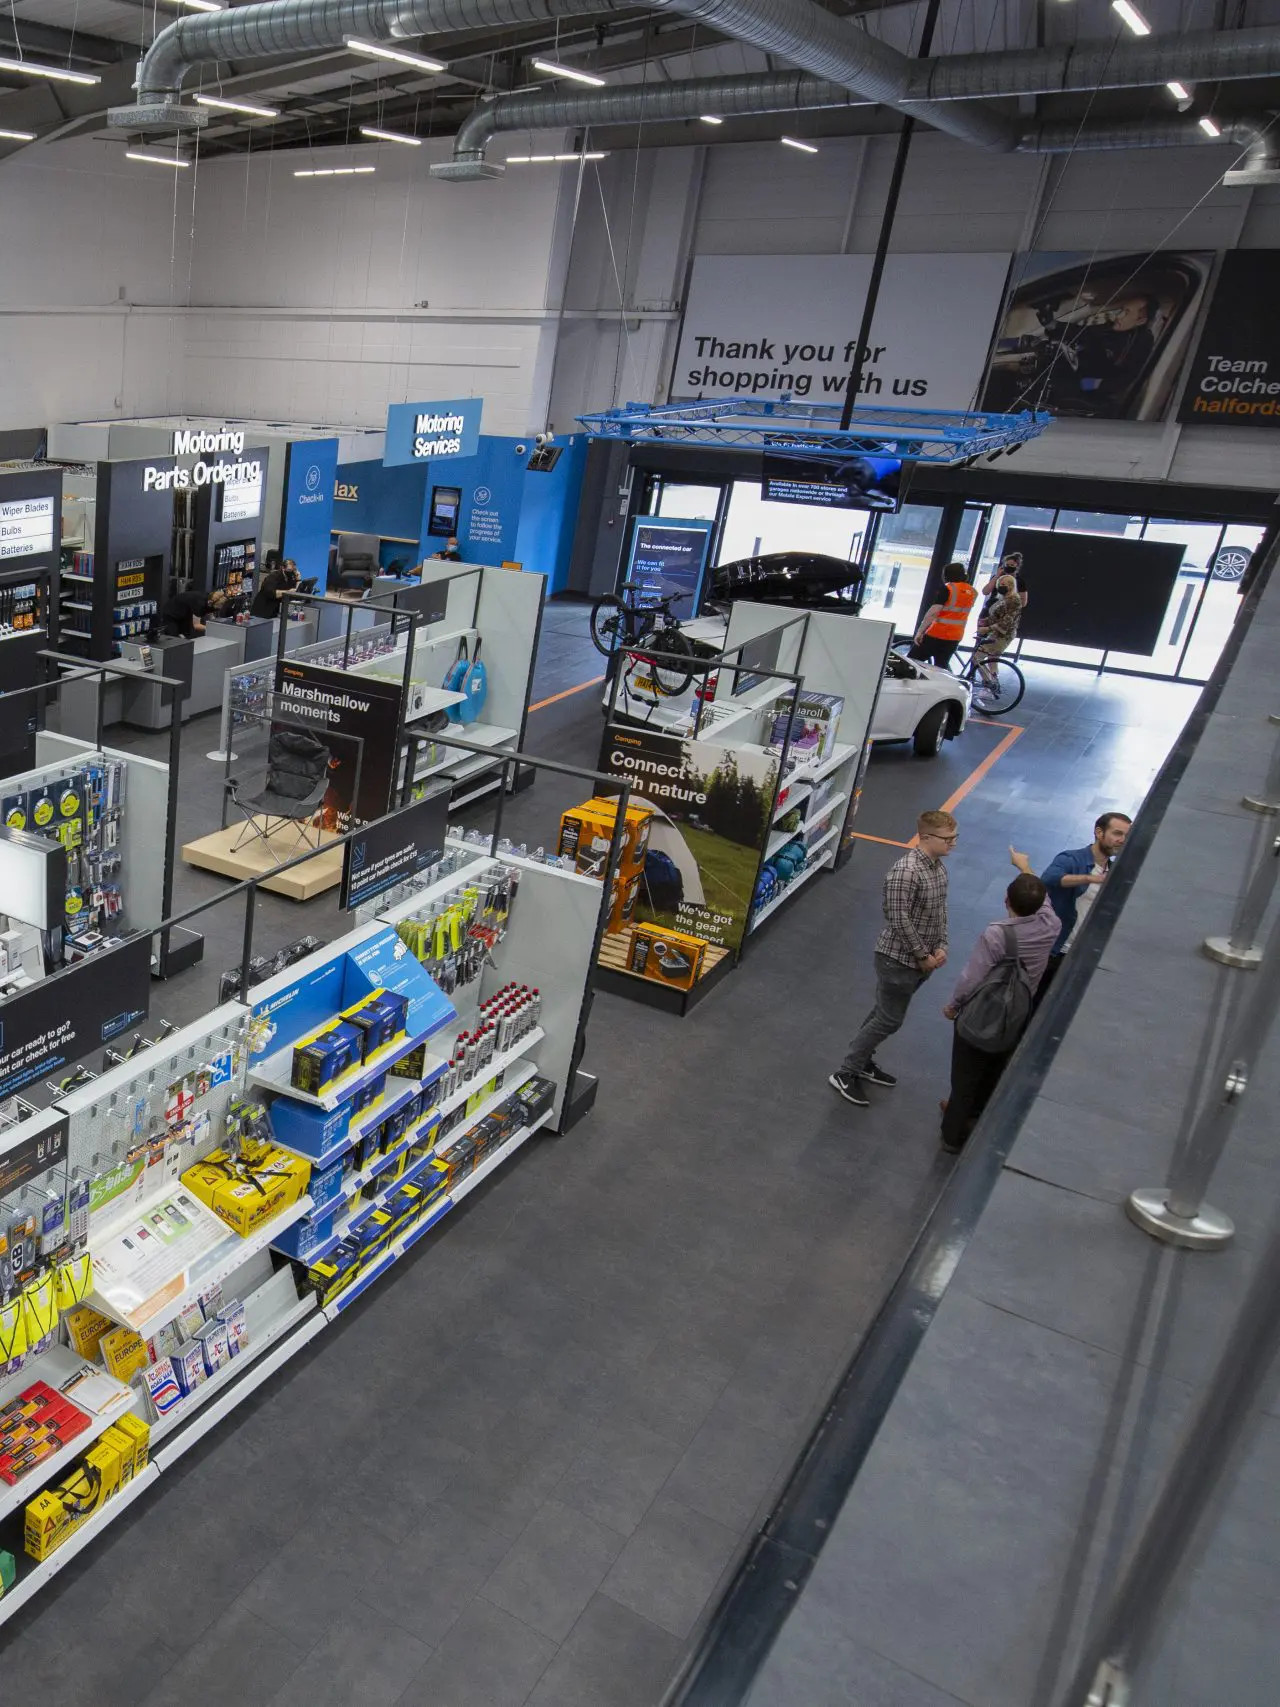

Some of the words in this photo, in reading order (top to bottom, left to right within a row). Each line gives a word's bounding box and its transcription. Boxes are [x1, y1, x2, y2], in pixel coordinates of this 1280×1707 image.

[694, 337, 775, 360] Thank
[782, 343, 834, 365] you
[844, 341, 886, 363] for
[1208, 355, 1268, 373] Team
[687, 365, 812, 395] shopping
[892, 376, 928, 396] us
[414, 412, 464, 434] Motoring
[173, 428, 244, 455] Motoring
[414, 436, 460, 457] Services
[144, 466, 189, 491] Parts
[193, 458, 260, 486] Ordering
[1, 506, 23, 517] Wiper
[24, 503, 49, 513] Blades
[298, 493, 324, 505] Check-in
[223, 509, 247, 519] Batteries
[472, 509, 488, 517] Check
[1, 526, 22, 536] Bulbs
[1, 544, 34, 556] Batteries
[651, 544, 682, 552] connected
[283, 667, 304, 678] Camping
[282, 681, 370, 713] Marshmallow
[280, 700, 341, 724] moments
[614, 735, 642, 746] Camping
[610, 750, 686, 780] Connect
[648, 782, 707, 805] nature
[336, 818, 349, 832] the
[351, 871, 361, 881] Not
[360, 869, 370, 877] sure
[375, 861, 384, 871] your
[395, 850, 403, 859] are
[675, 913, 693, 927] the
[695, 917, 722, 934] gear
[676, 901, 710, 922] We've
[713, 910, 733, 926] got
[270, 988, 300, 1008] MICHELIN
[11, 1047, 24, 1060] car
[25, 1034, 47, 1053] ready
[47, 1028, 56, 1039] to
[56, 1019, 71, 1036] go?
[11, 1058, 25, 1071] car
[25, 1044, 48, 1064] check
[49, 1039, 61, 1053] for
[60, 1031, 76, 1046] free
[12, 1243, 24, 1272] GB
[80, 1317, 108, 1341] EUROPE
[114, 1339, 142, 1364] EUROPE
[39, 1498, 52, 1510] AA
